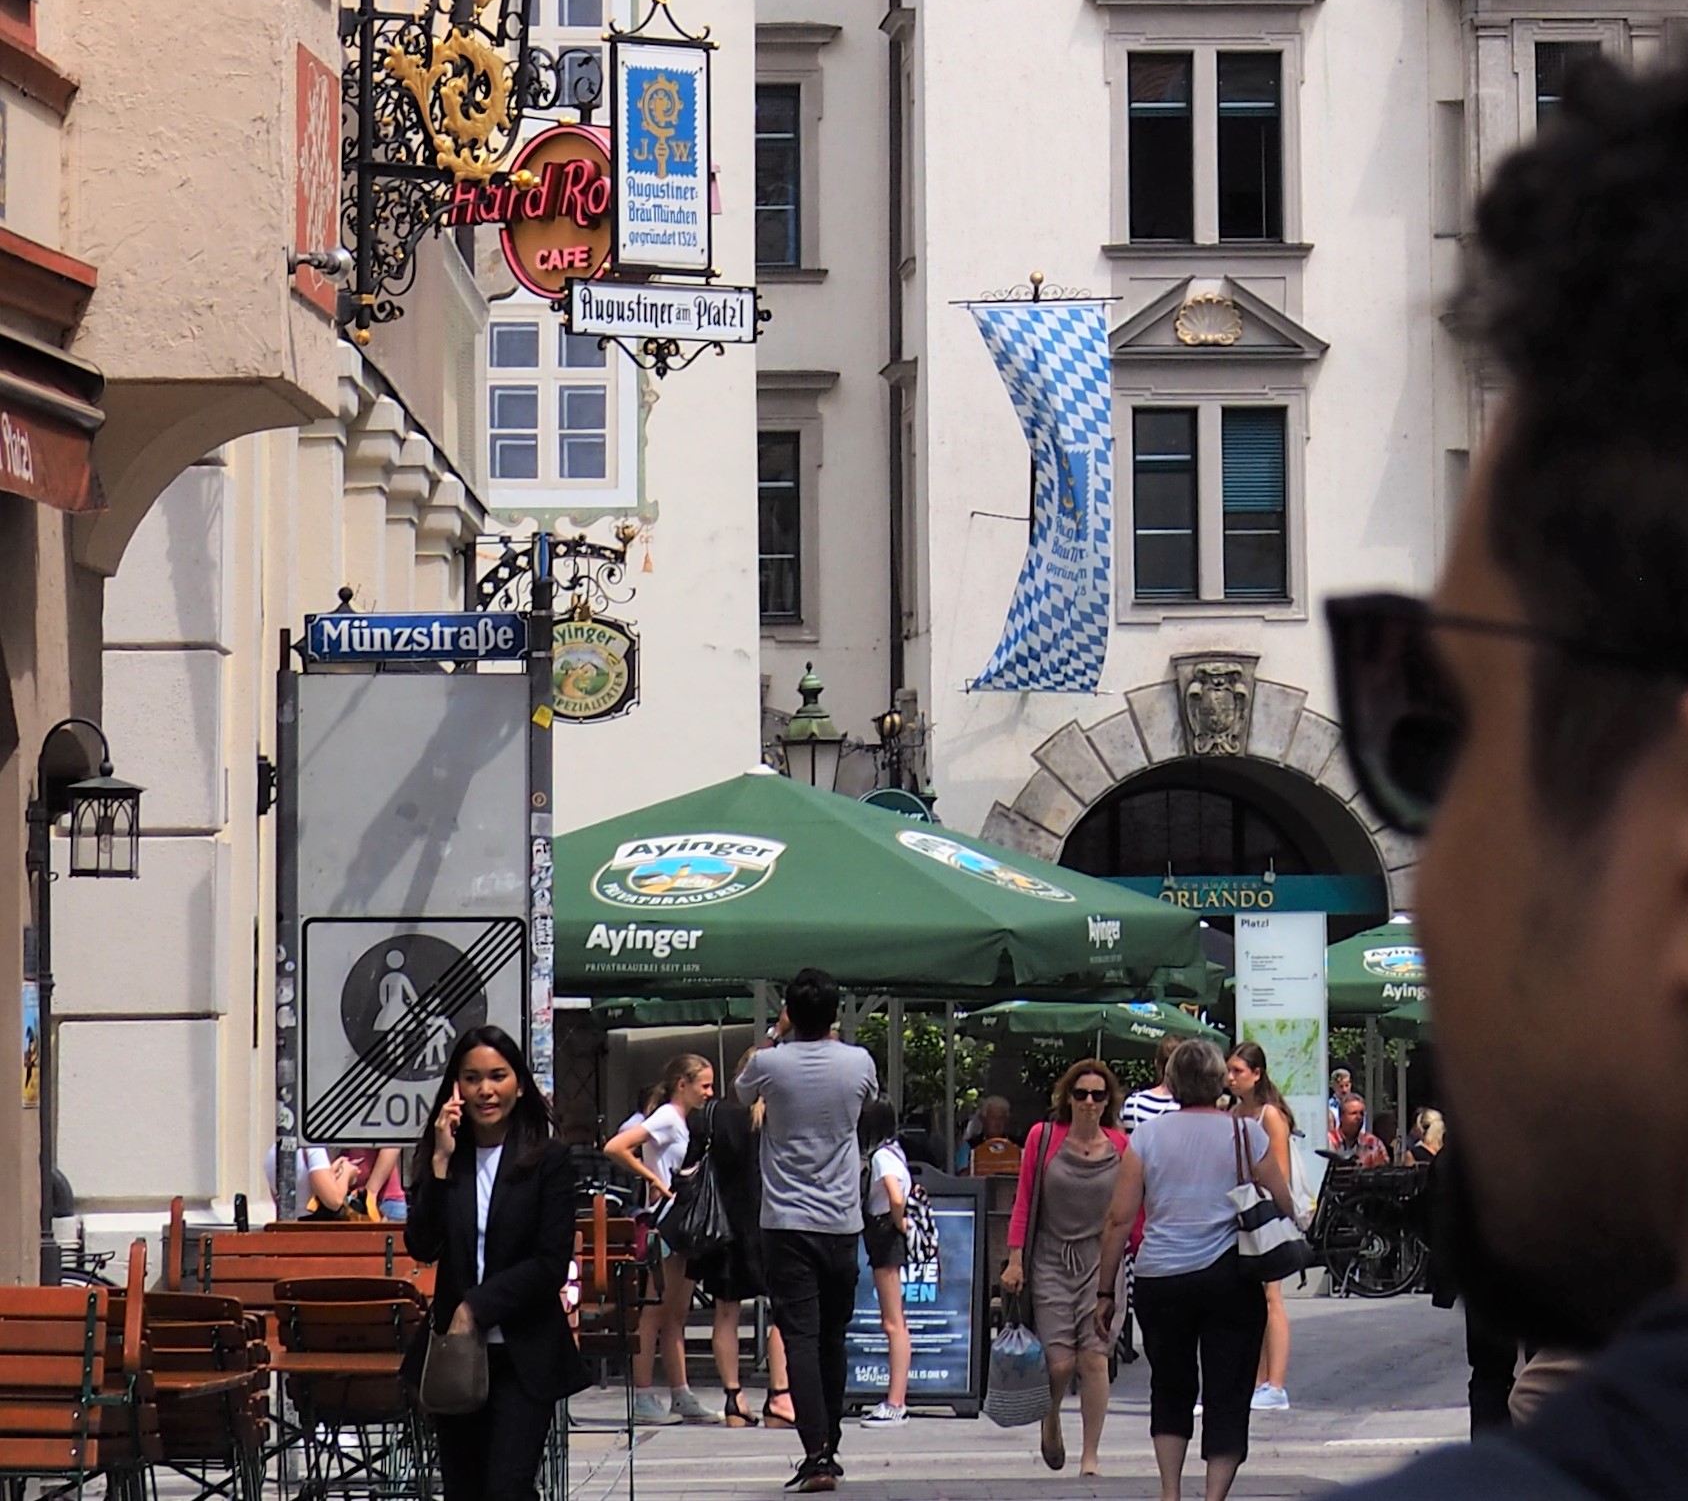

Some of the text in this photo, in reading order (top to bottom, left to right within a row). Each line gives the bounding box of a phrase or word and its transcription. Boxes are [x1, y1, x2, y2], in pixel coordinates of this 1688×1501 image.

[449, 159, 611, 227] Hard Ro
[629, 229, 677, 247] gegründet
[535, 245, 590, 271] CAFE
[579, 286, 674, 328] Augustiner
[675, 305, 691, 321] am
[321, 617, 514, 656] Münzstraße
[553, 624, 617, 646] yinger
[625, 838, 774, 859] Ayinger
[602, 881, 746, 905] PRIVATBRAUEREI
[1159, 889, 1275, 909] ORLANDO
[1241, 918, 1269, 928] Platzl
[585, 923, 704, 958] Ayinger
[585, 963, 658, 973] PRIVATBRAUEREI
[1130, 1021, 1166, 1038] Ayinger
[360, 1093, 432, 1127] ZON
